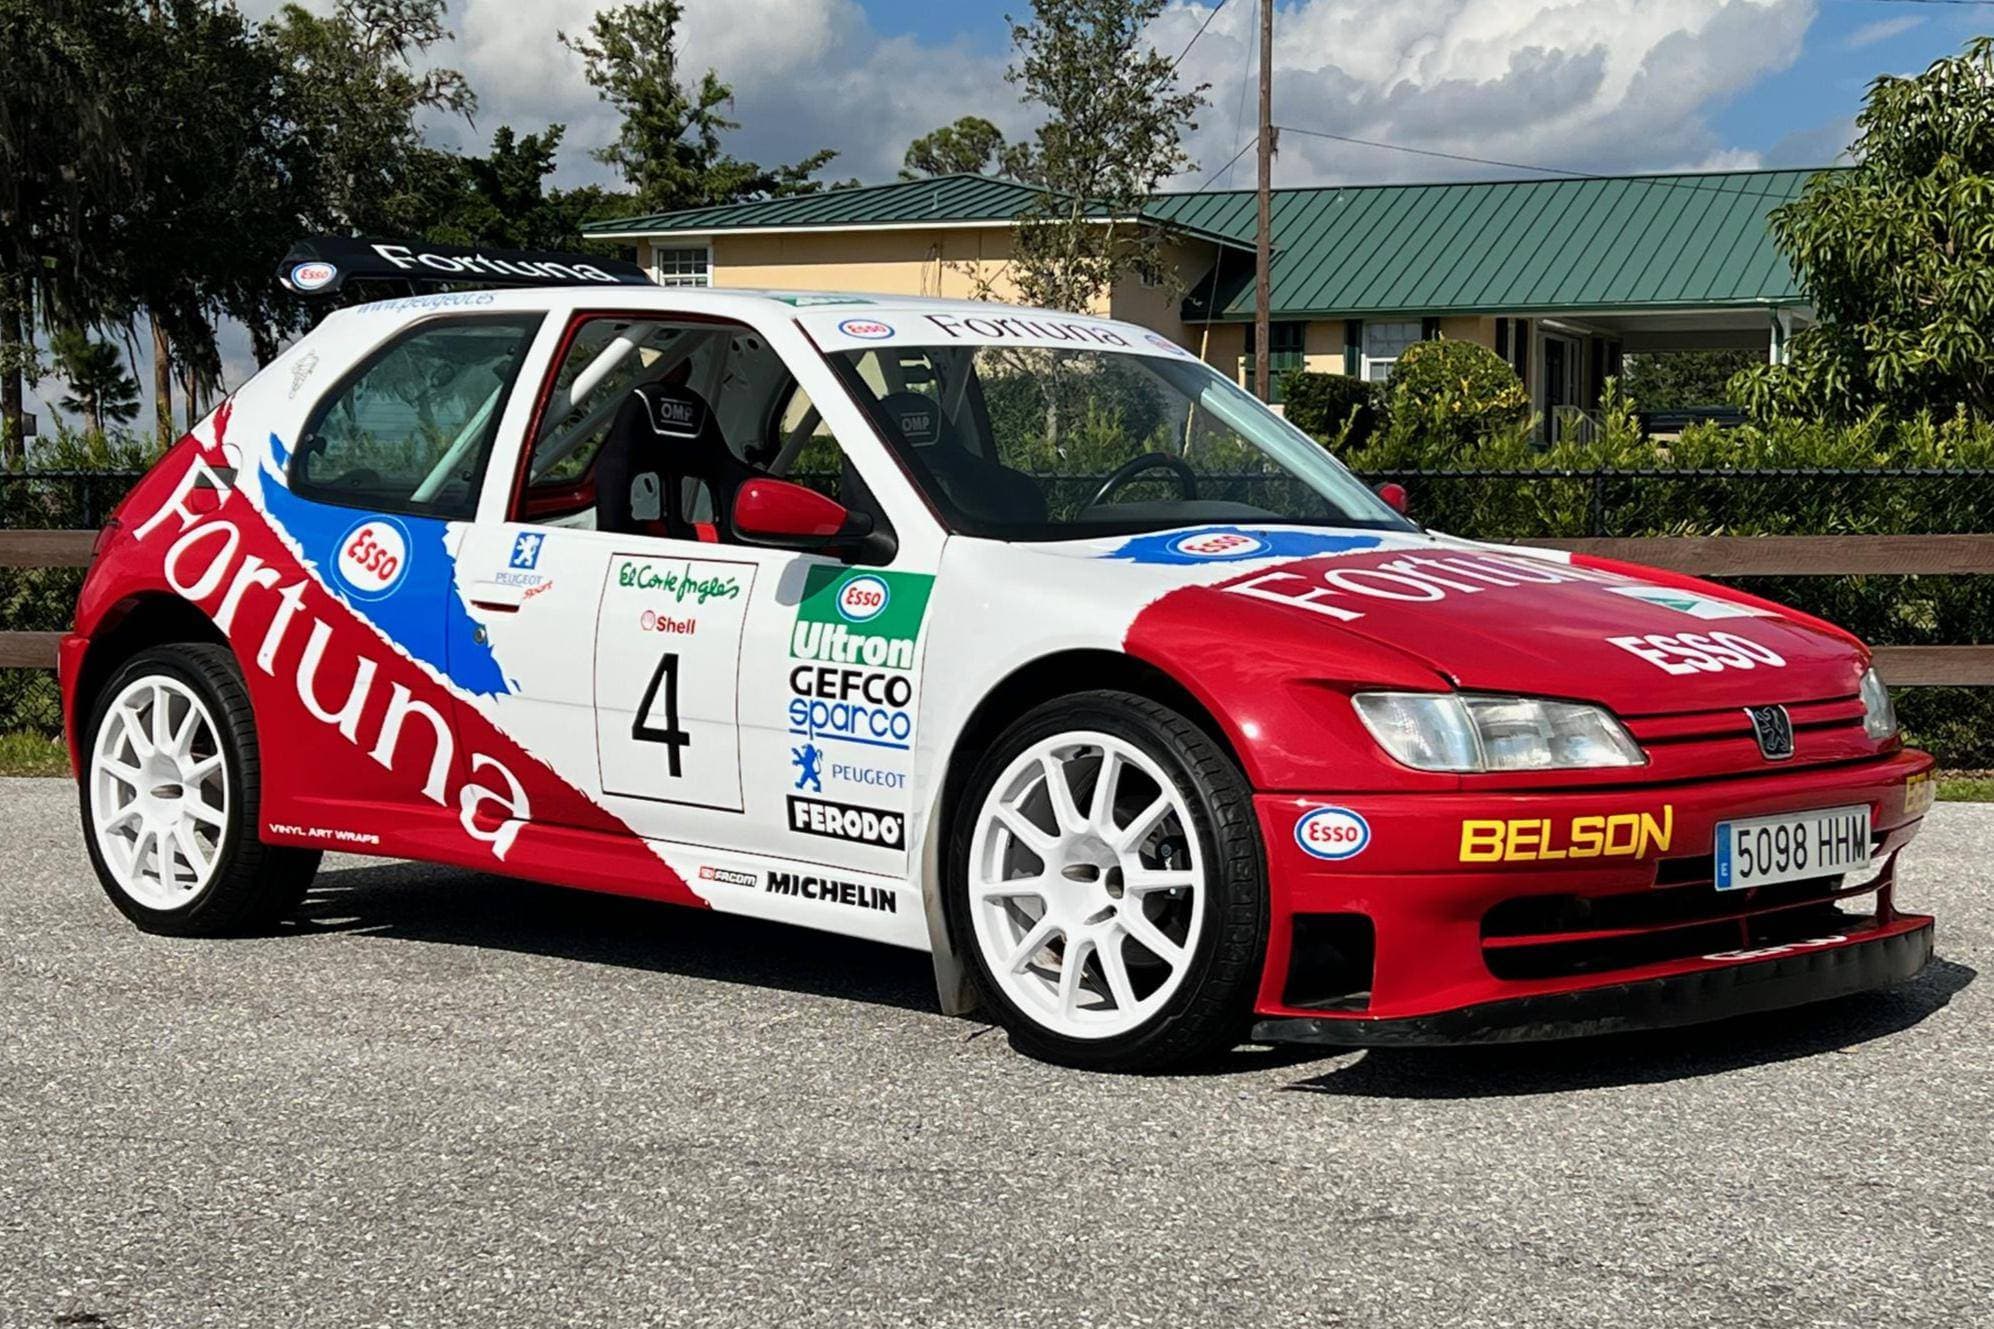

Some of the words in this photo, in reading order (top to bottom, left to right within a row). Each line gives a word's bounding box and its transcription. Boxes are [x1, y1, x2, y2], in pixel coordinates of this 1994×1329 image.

[371, 243, 620, 283] Fortuna
[922, 313, 1132, 348] Fortuna
[660, 401, 694, 422] OMP
[901, 415, 931, 431] OMP
[495, 571, 543, 586] PEUGEOT
[619, 561, 636, 587] El
[636, 564, 677, 593] Corte
[675, 561, 740, 605] Inglés
[655, 615, 697, 636] Shell
[792, 620, 914, 670] Ultron
[132, 452, 531, 863] Fortuna
[1604, 631, 1788, 676] ESSO
[788, 665, 913, 708] GEFCO
[631, 652, 691, 778] 4
[788, 699, 911, 740] sparco
[831, 763, 907, 790] PEUGEOT
[268, 823, 307, 837] VINYL
[307, 827, 334, 839] ART
[334, 830, 380, 845] WRAPS
[793, 800, 900, 846] FERODO
[1458, 803, 1674, 862] BELSON
[1737, 822, 1808, 879] 5098
[1818, 814, 1866, 868] HHM
[765, 870, 897, 914] MICHELIN
